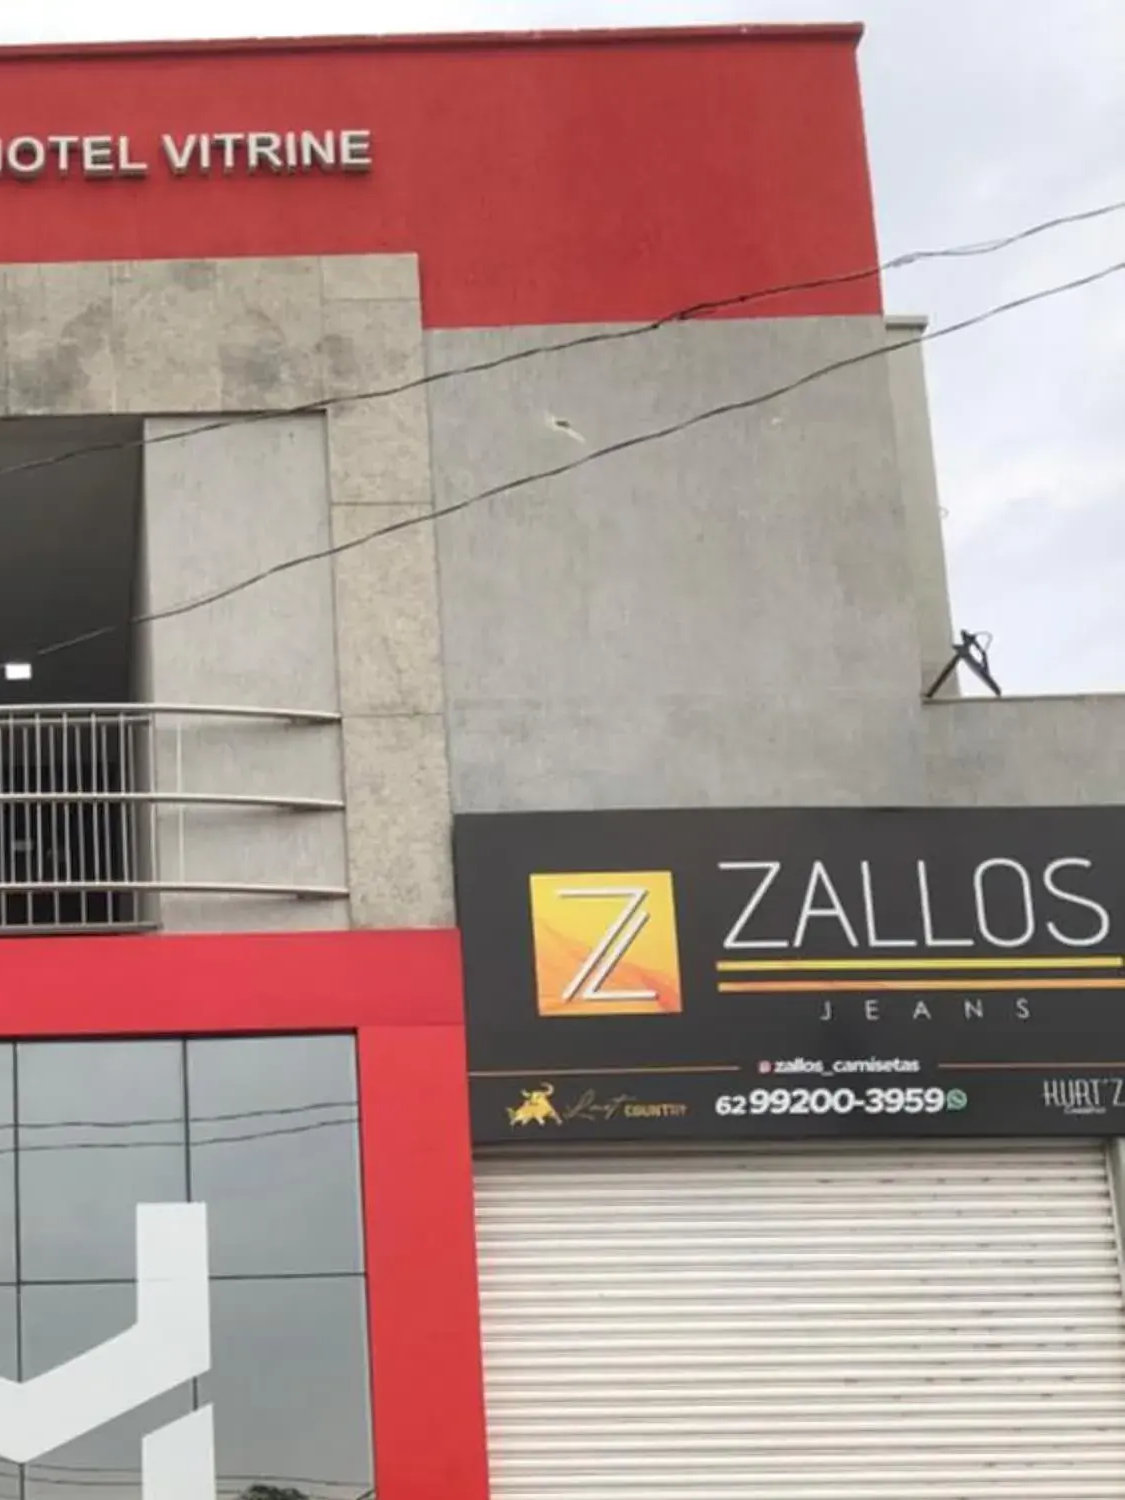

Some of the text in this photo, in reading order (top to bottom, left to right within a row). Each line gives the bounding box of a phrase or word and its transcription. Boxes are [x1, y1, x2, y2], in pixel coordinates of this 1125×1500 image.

[162, 129, 373, 176] VITRINE
[717, 857, 1111, 949] ZALLOS
[820, 998, 1031, 1021] JEANS
[774, 1056, 921, 1077] zallos_camisetas
[715, 1087, 945, 1115] 62 99200-3959
